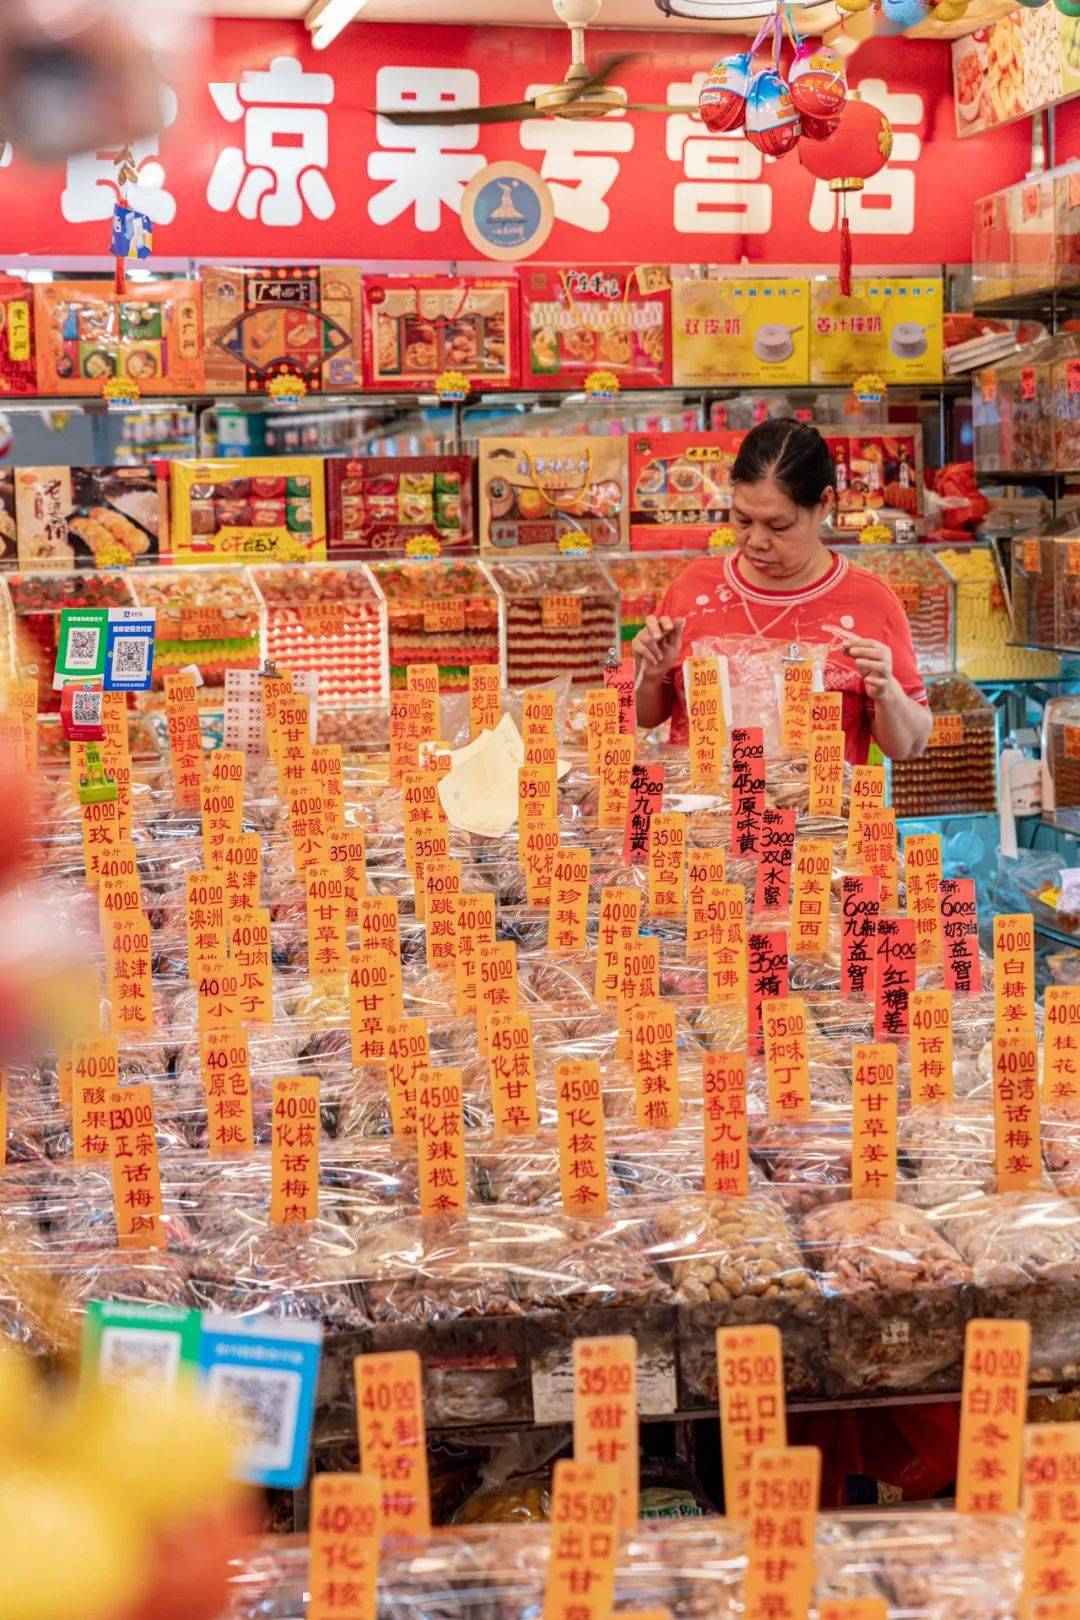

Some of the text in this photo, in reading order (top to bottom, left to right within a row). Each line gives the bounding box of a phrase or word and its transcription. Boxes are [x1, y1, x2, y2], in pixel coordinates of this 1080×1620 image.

[684, 318, 741, 336] 双皮奶
[817, 316, 882, 334] 姜汁撞奶
[630, 799, 654, 857] 九制黄
[313, 905, 340, 973] 甘草李
[710, 923, 743, 998] 特级金佛
[114, 958, 148, 1022] 盐津辣桃
[1001, 958, 1027, 1022] 白糖姜
[356, 995, 385, 1057] 甘草梅
[769, 1040, 805, 1110] 和味丁香
[918, 1036, 946, 1100] 话梅姜
[1052, 1035, 1078, 1097] 桂花姜
[81, 1087, 110, 1153] 酸果梅
[209, 1073, 248, 1145] 原色樱桃
[860, 1094, 889, 1188] 甘草姜片
[1000, 1079, 1034, 1174] 台湾话梅姜
[115, 1131, 155, 1234] 正宗话梅肉
[276, 1123, 316, 1223] 化核话梅肉
[420, 1111, 460, 1213] 化核辣榄条
[566, 1108, 600, 1204] 化核榄条
